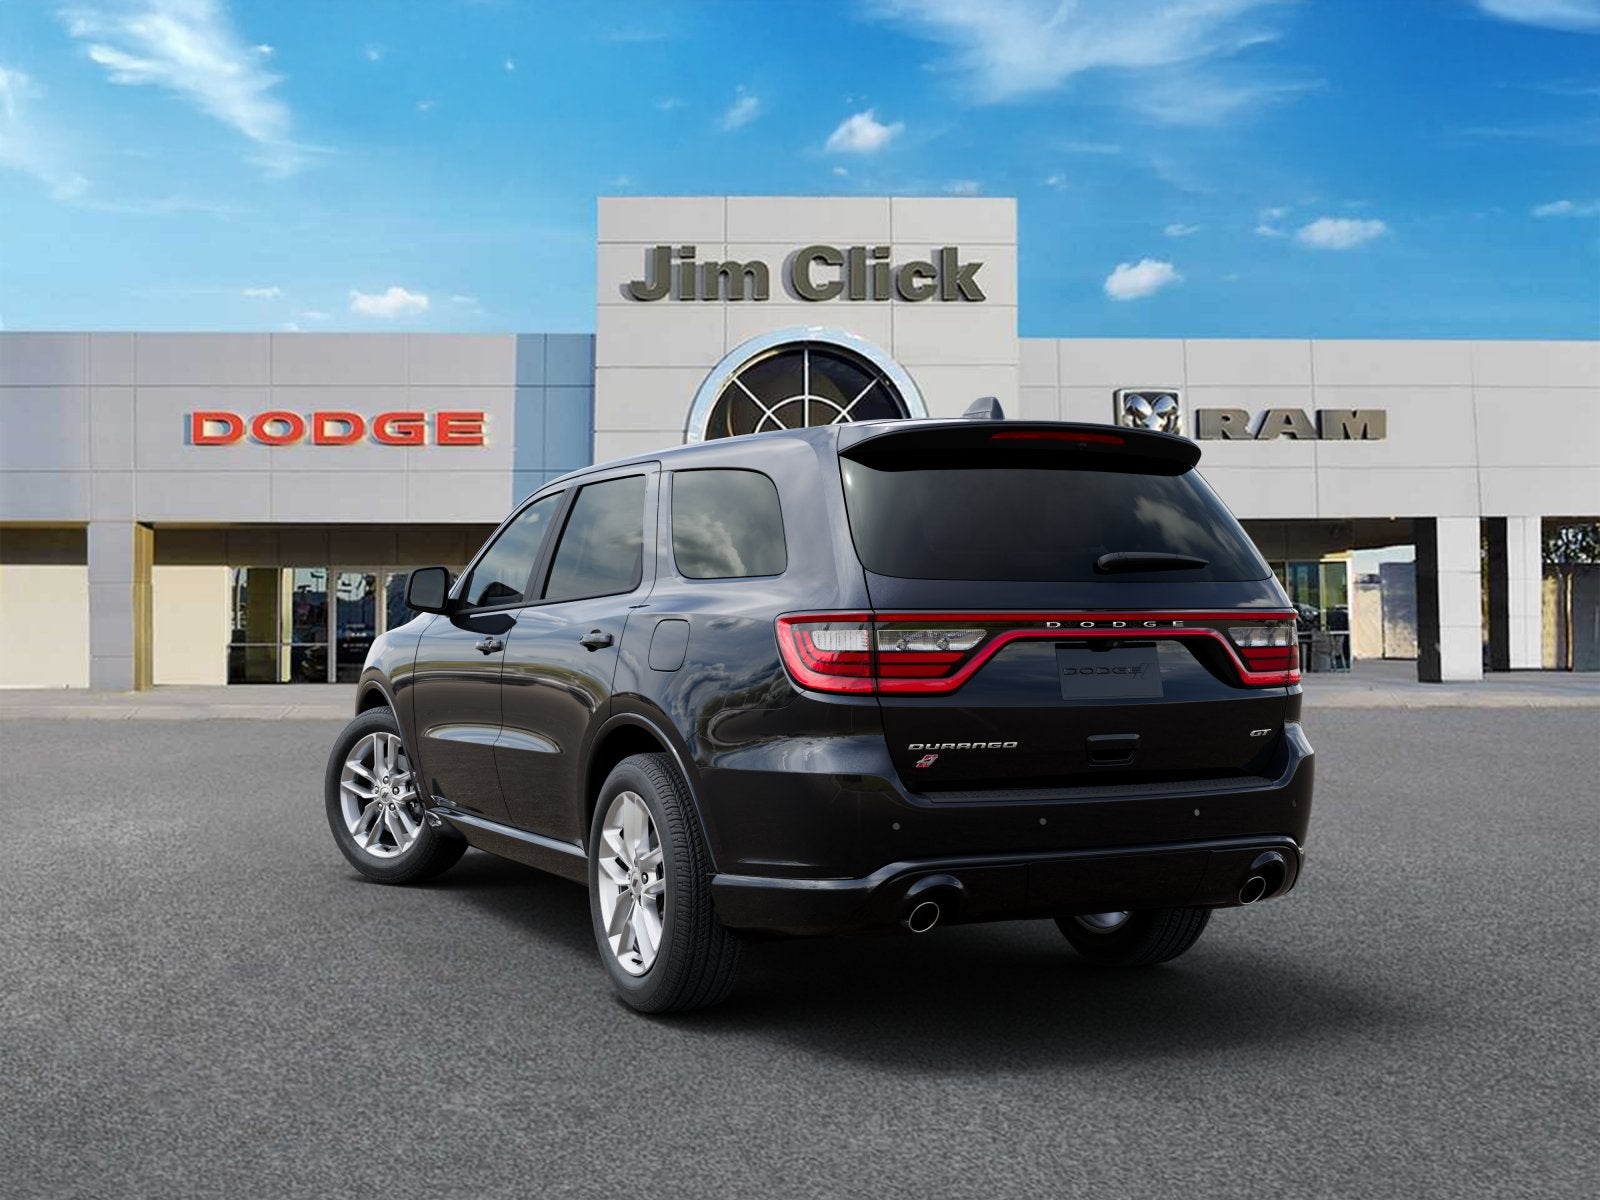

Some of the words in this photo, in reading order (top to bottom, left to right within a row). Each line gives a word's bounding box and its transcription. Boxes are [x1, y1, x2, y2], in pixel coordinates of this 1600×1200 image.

[627, 244, 771, 302] Jim
[788, 244, 987, 302] Click
[189, 410, 486, 447] DODGE
[1194, 408, 1387, 441] RAM
[1046, 620, 1185, 629] DODGE
[1062, 665, 1143, 677] DODGE
[1249, 728, 1272, 737] GT
[907, 741, 1018, 751] DURANGO
